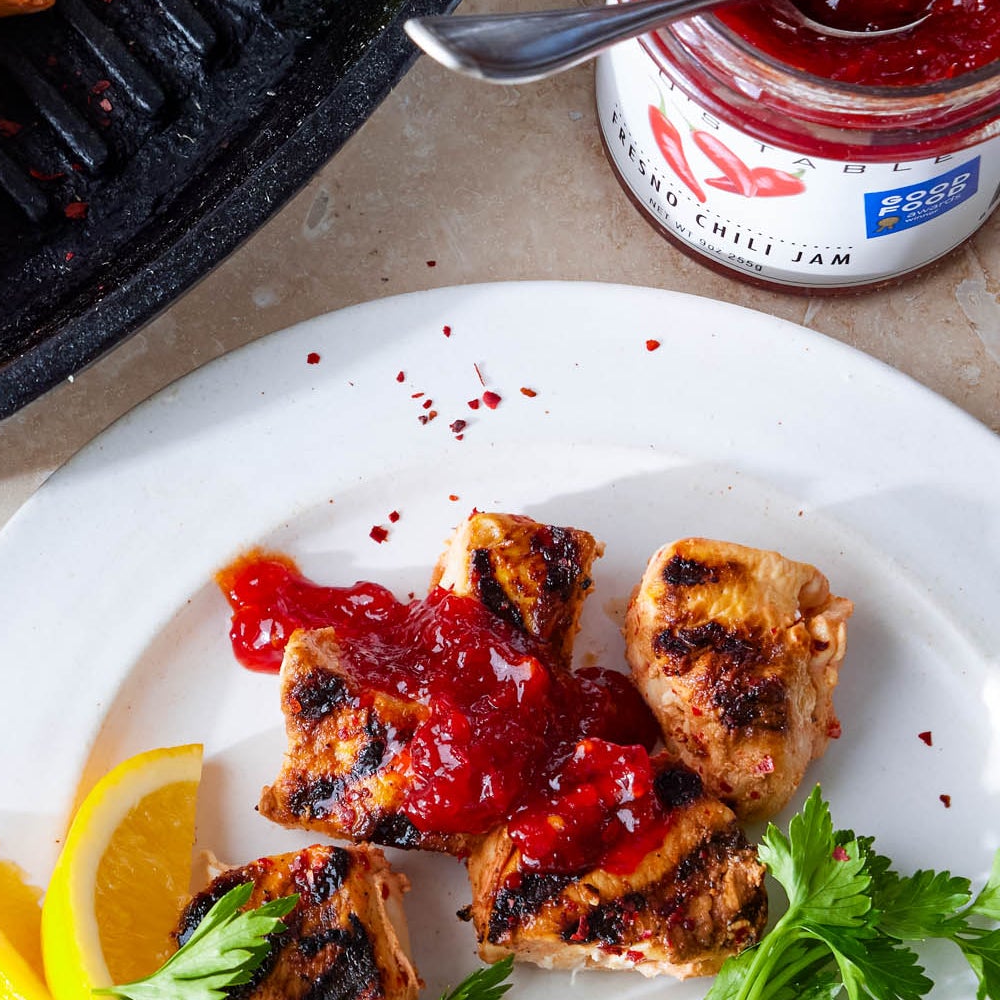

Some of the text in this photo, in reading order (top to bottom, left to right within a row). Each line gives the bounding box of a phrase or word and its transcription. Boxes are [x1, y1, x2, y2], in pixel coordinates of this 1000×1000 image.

[612, 110, 851, 266] FRESNO CHILI JAM
[878, 183, 968, 217] FOOD
[881, 172, 971, 206] GOOD
[649, 197, 669, 219] NET
[727, 252, 763, 272] 255g
